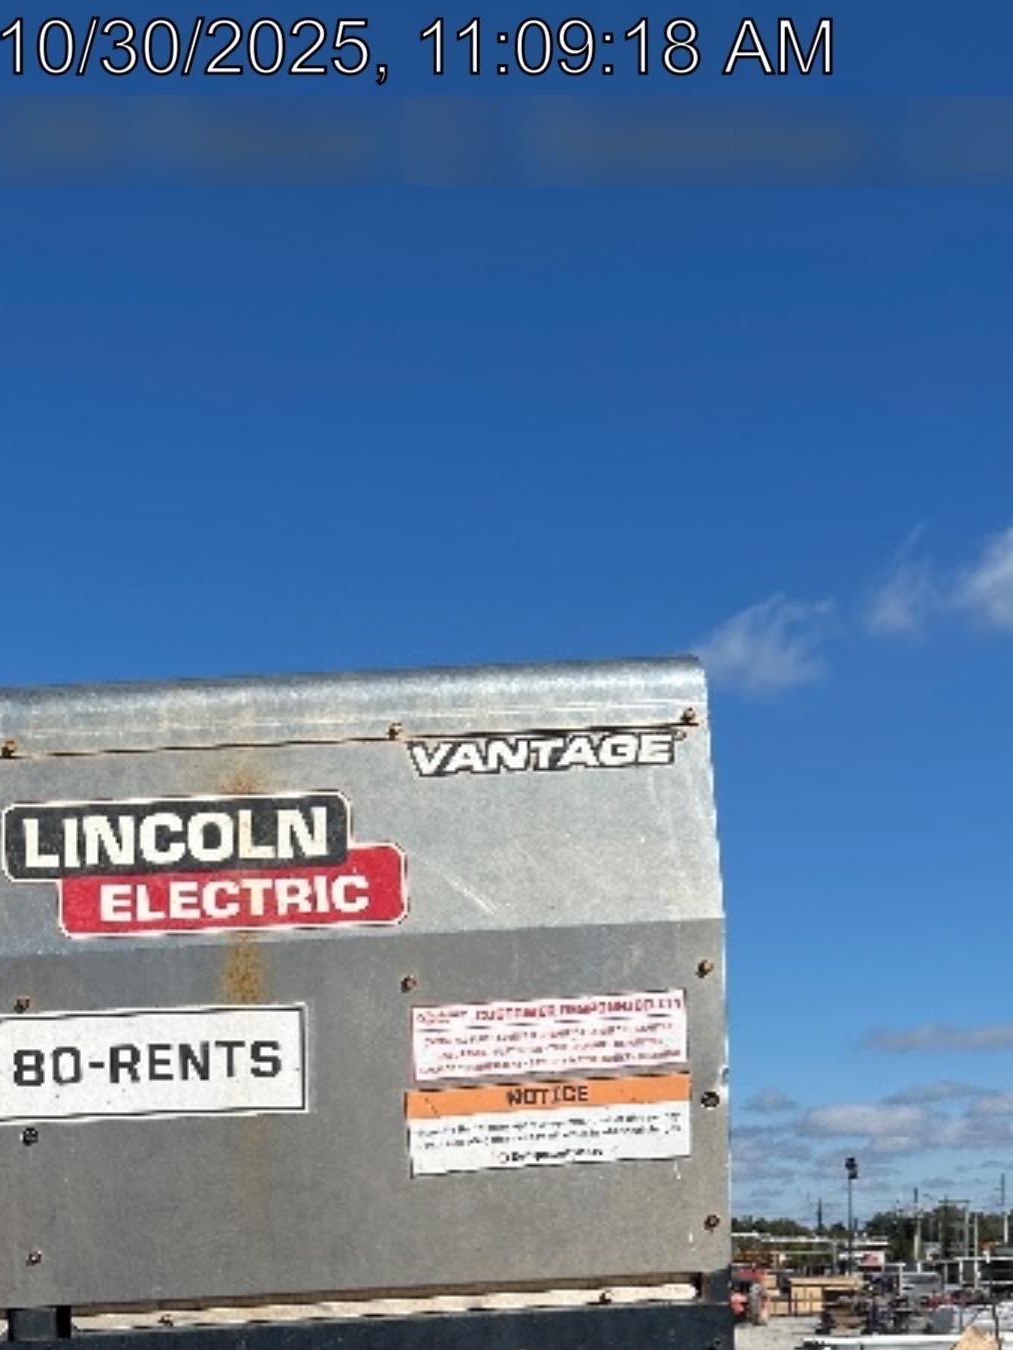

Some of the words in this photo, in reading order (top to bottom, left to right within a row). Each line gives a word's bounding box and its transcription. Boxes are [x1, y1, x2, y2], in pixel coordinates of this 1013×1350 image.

[407, 731, 675, 777] VANTAGE
[22, 806, 329, 869] LINCOLN
[99, 873, 370, 923] ELECTRIC
[12, 1040, 282, 1089] 80-RENTS
[506, 1085, 589, 1106] NOTICE
